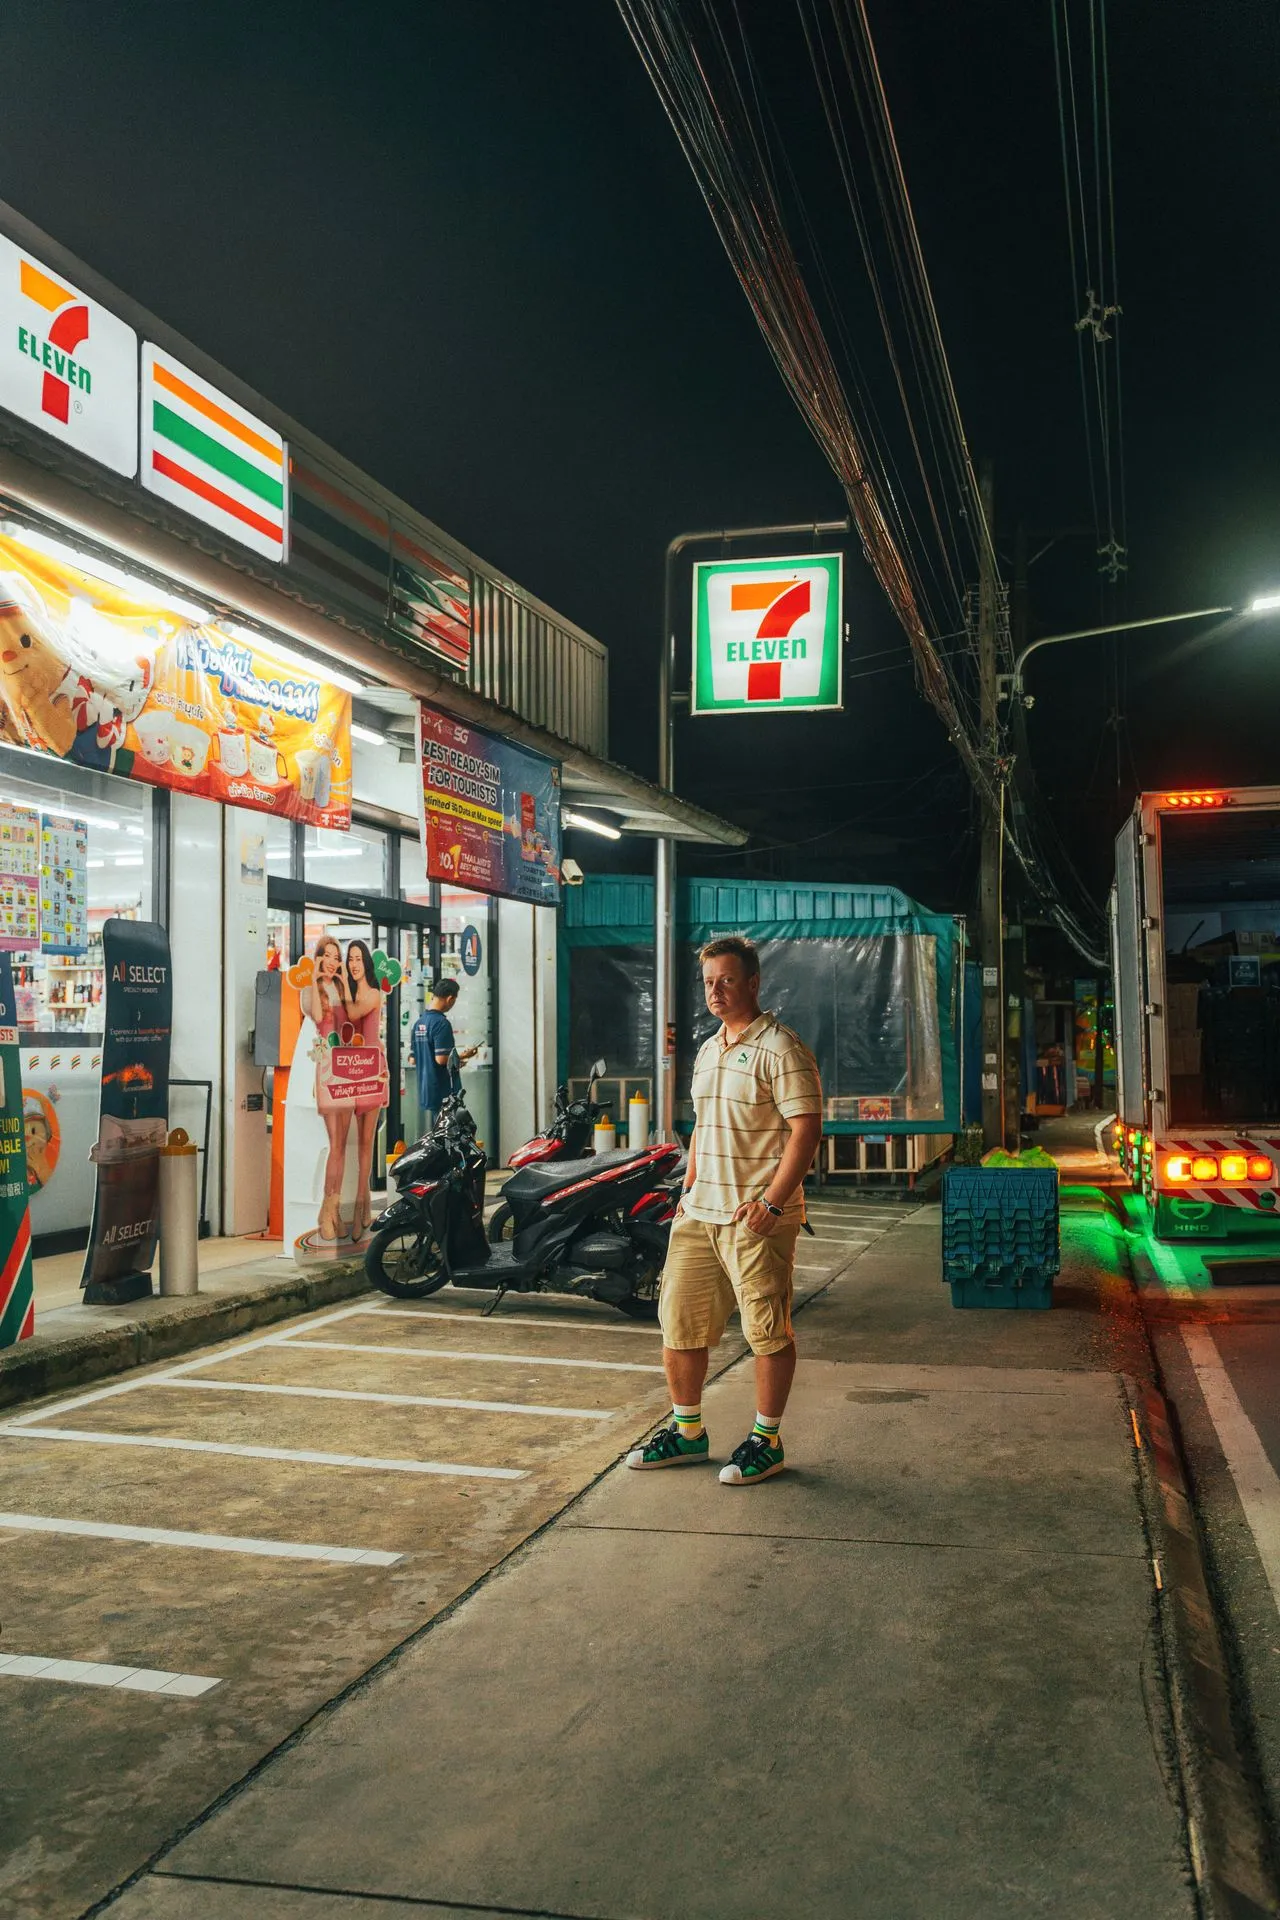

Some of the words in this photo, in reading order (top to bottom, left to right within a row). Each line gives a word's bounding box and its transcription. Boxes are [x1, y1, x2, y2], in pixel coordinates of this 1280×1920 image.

[453, 726, 469, 744] 5G
[424, 739, 449, 764] BEST
[450, 749, 500, 785] READY-SIM
[428, 765, 451, 789] FOR
[451, 772, 497, 805] TOURISTS
[458, 805, 471, 817] Data
[477, 811, 487, 823] Max
[129, 965, 167, 983] SELECT
[118, 1219, 152, 1241] SELECT
[1174, 1224, 1209, 1232] HINO
